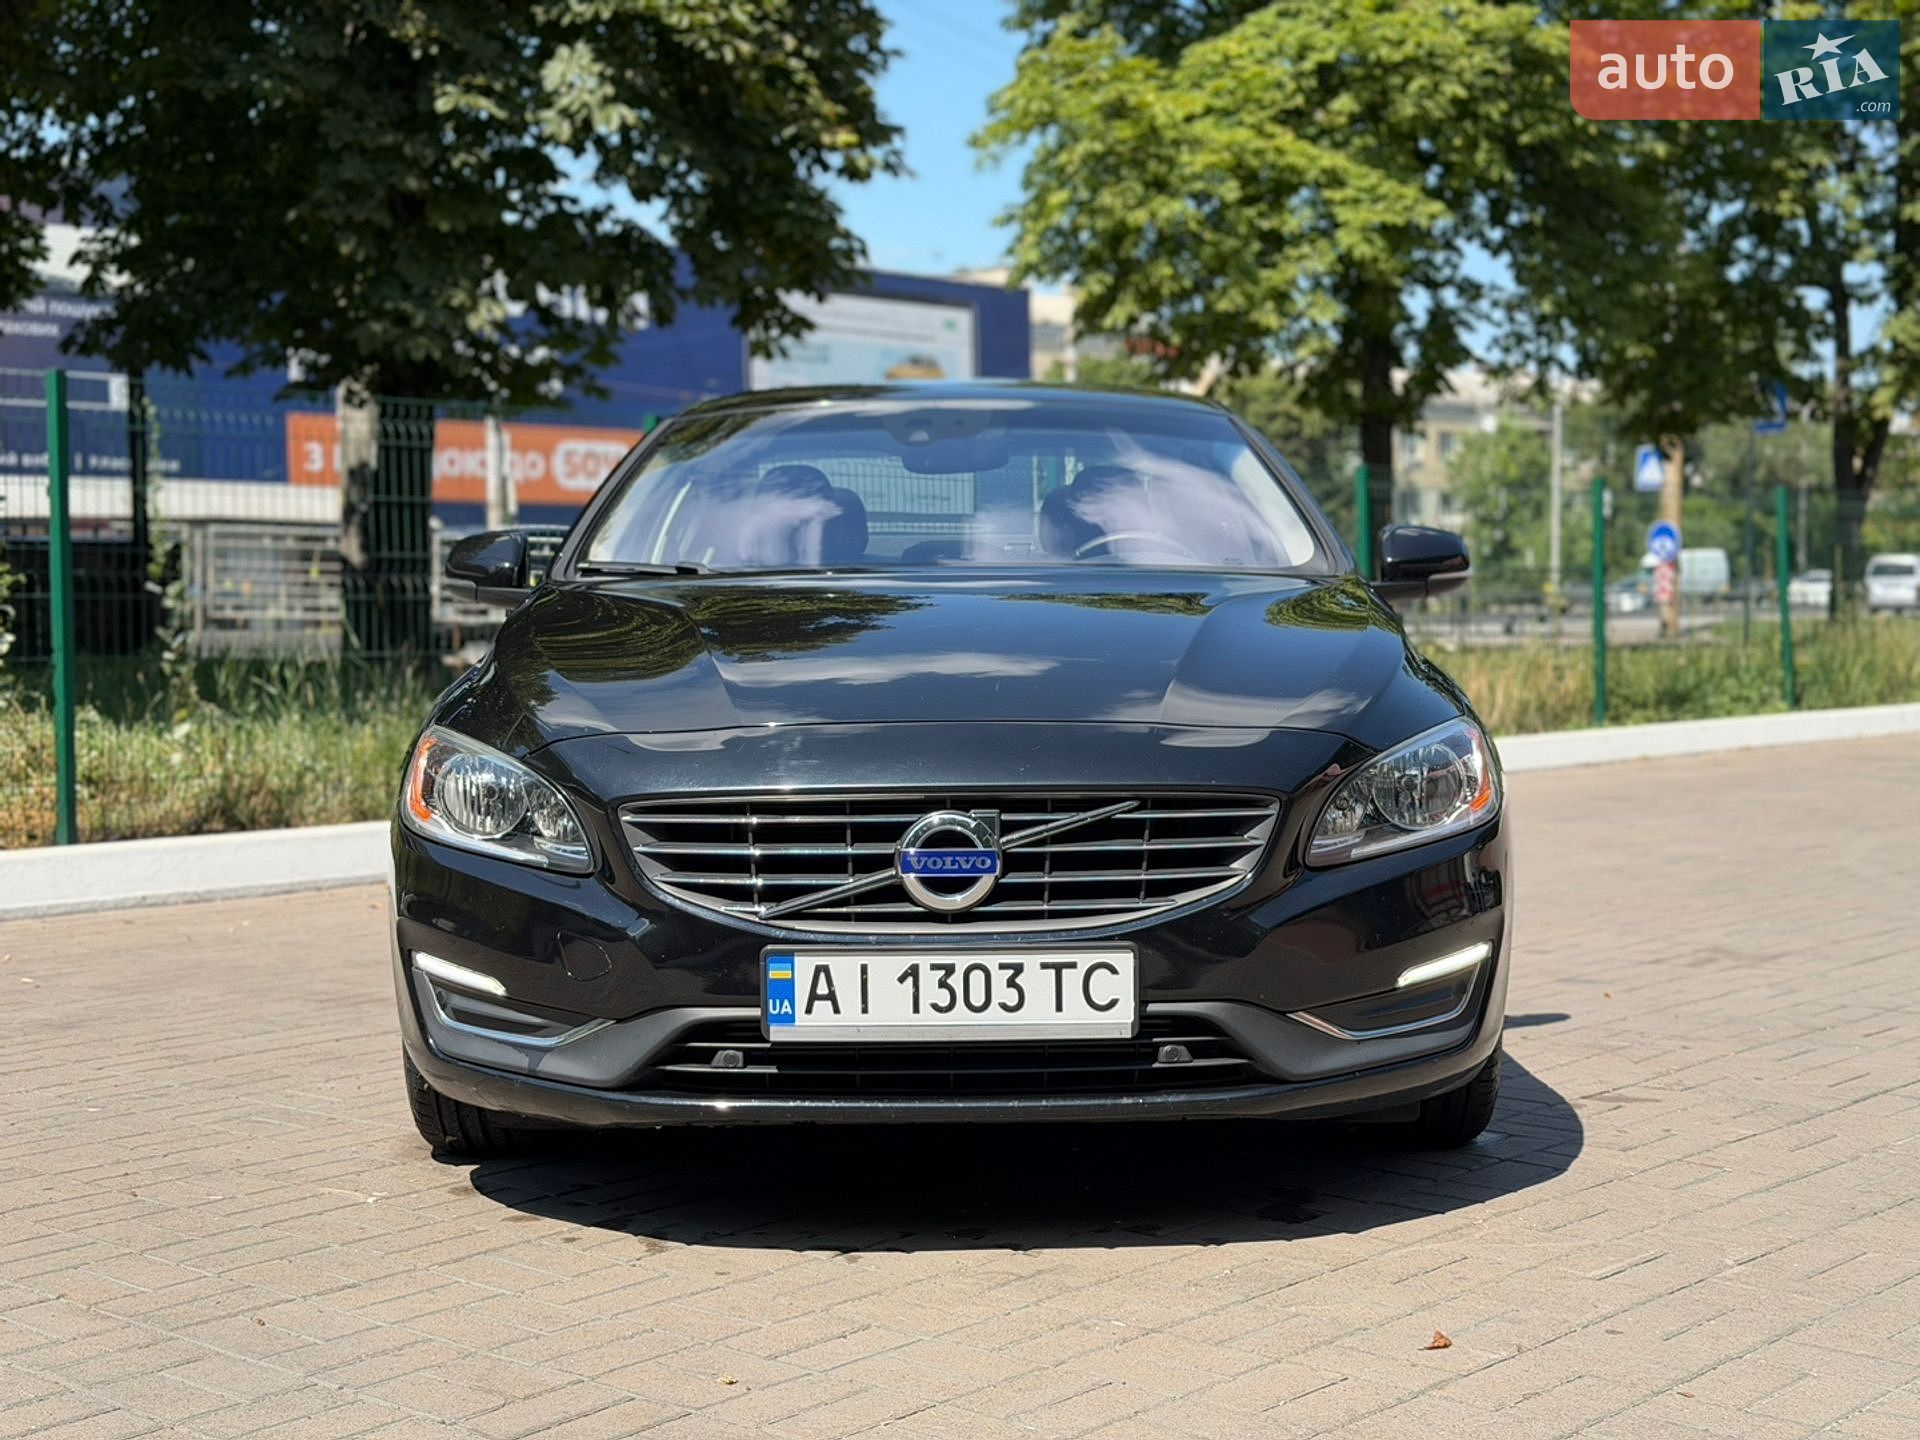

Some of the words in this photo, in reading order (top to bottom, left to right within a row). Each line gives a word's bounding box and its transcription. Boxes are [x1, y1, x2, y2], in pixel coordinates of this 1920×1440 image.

[907, 855, 992, 870] VOLVO
[804, 963, 869, 1015] AI
[896, 962, 1026, 1014] 1303
[1039, 961, 1120, 1013] TC
[769, 998, 793, 1015] UA
